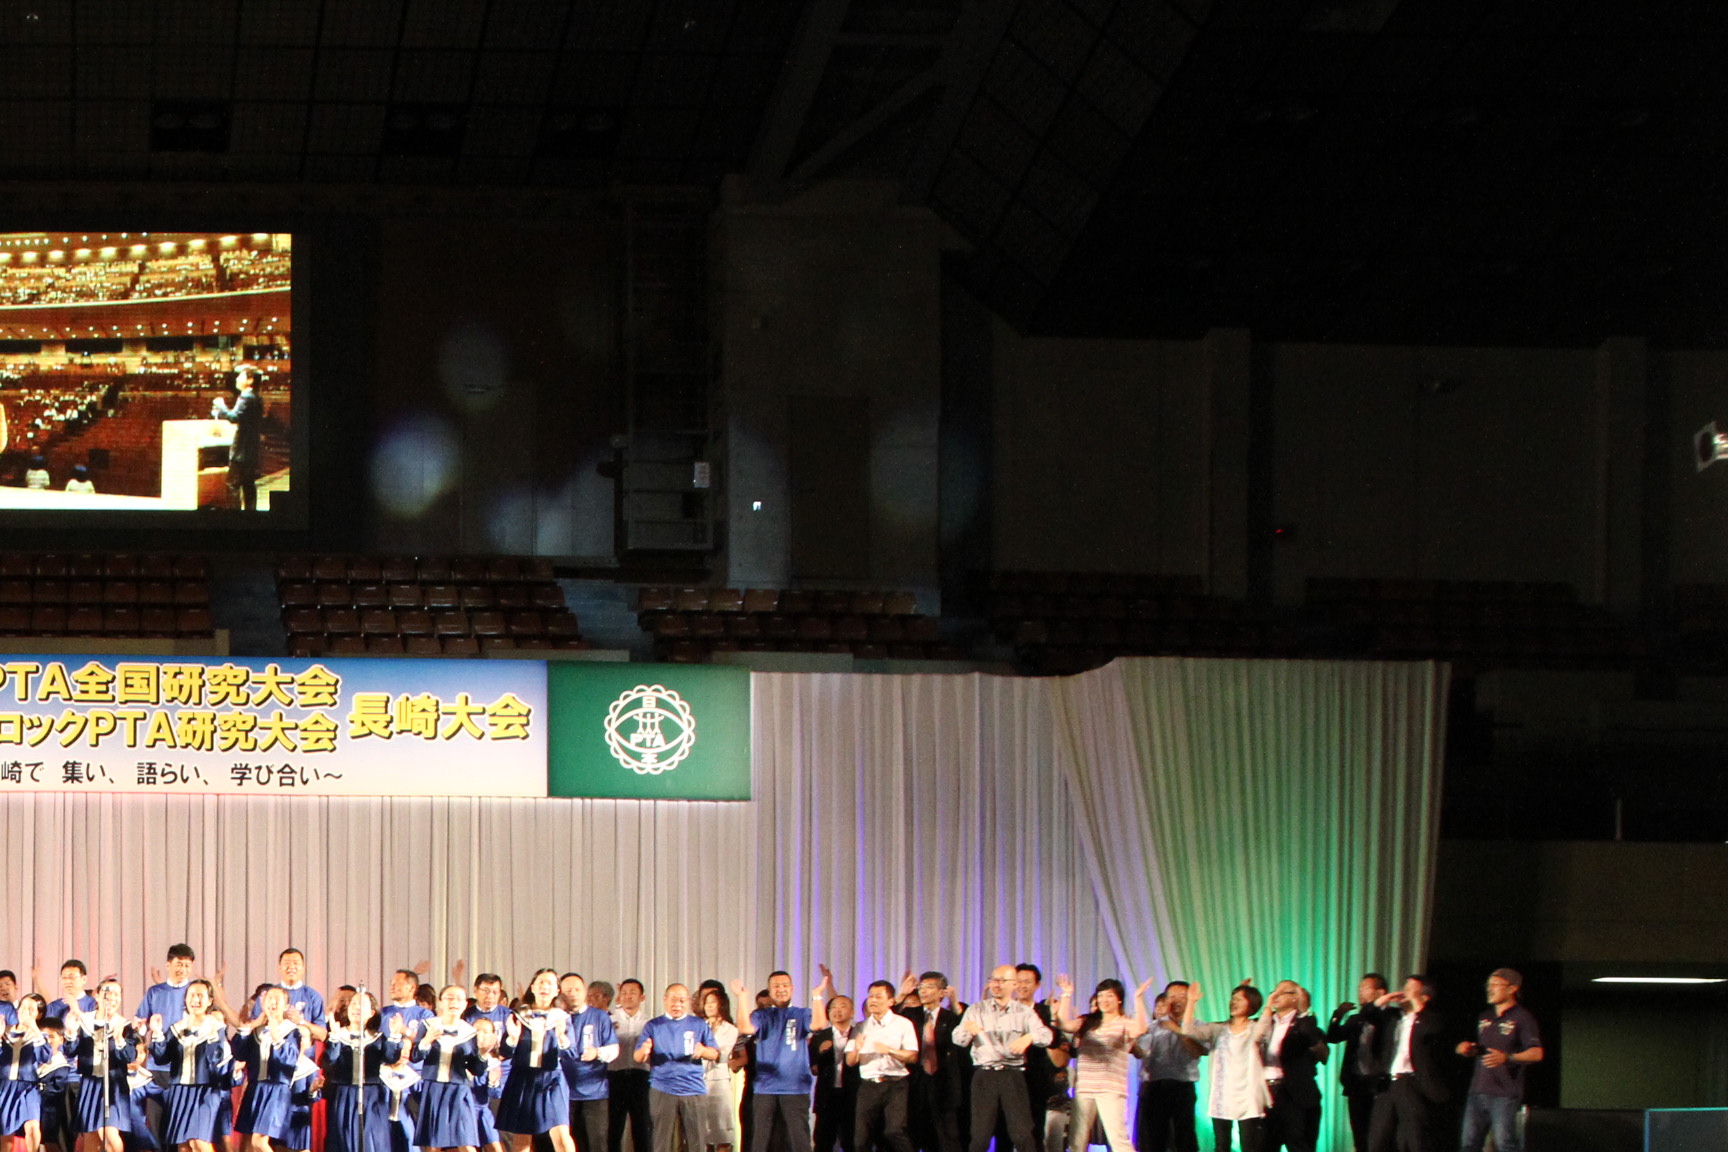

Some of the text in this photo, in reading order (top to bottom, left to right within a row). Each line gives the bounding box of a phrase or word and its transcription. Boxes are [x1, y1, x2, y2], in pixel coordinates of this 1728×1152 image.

[349, 695, 532, 740] 長崎大会
[630, 733, 666, 747] PTA
